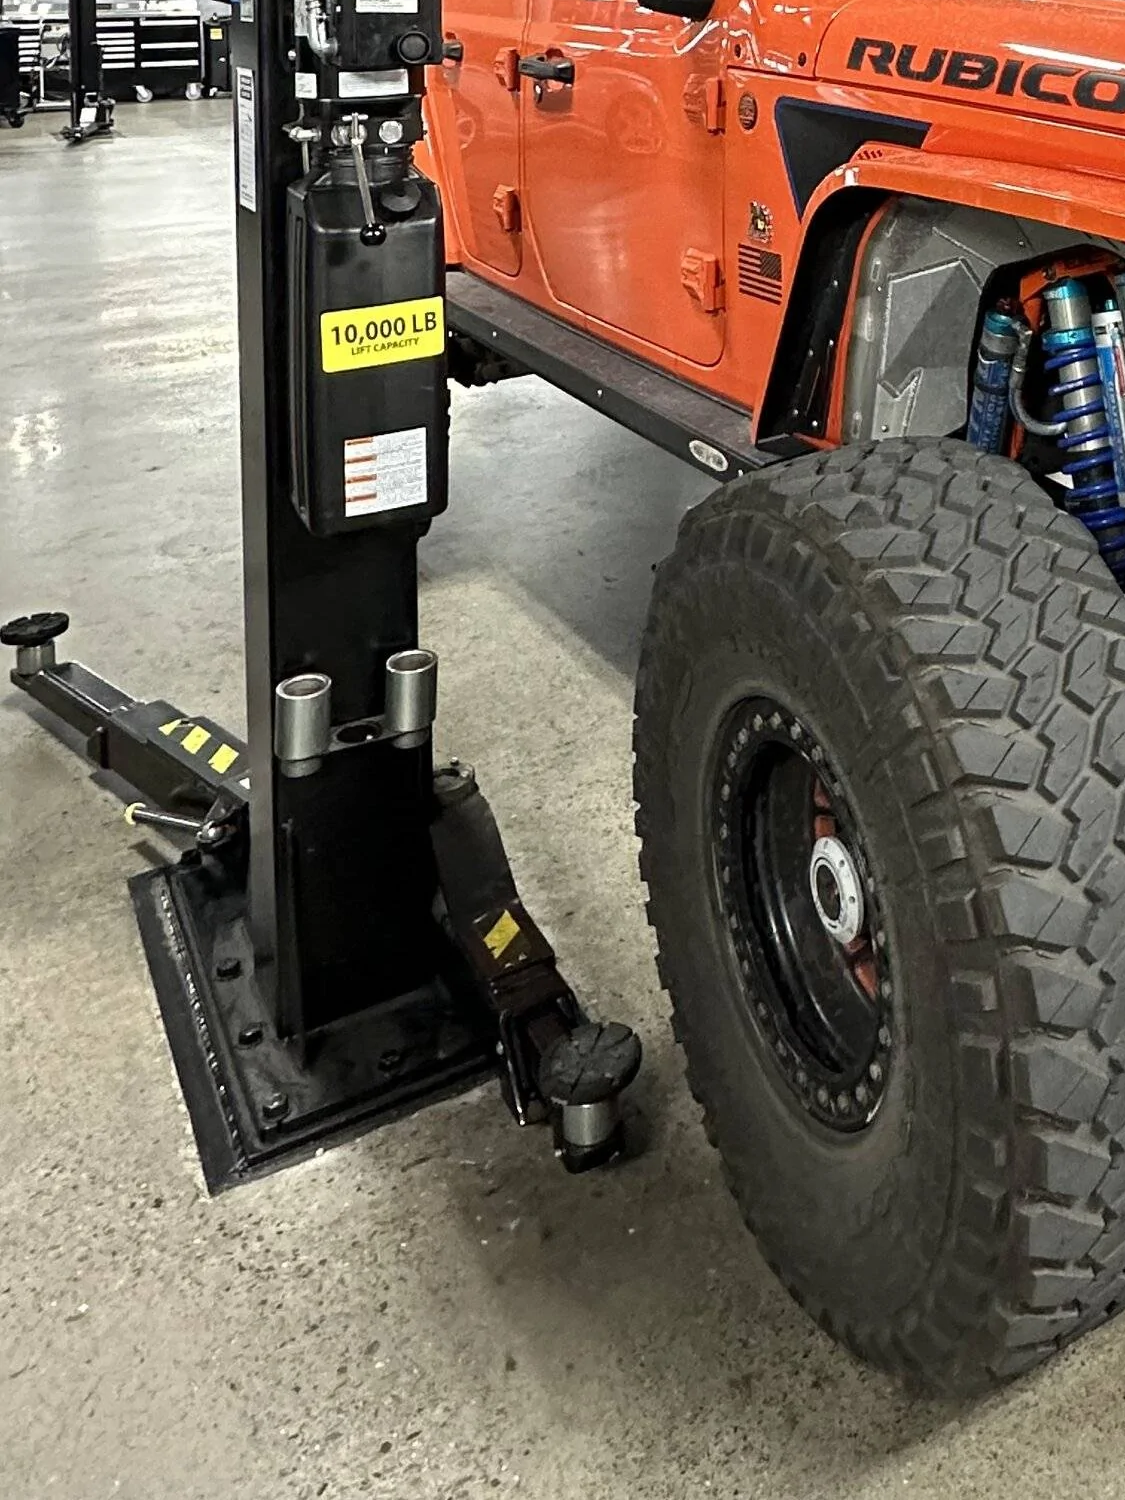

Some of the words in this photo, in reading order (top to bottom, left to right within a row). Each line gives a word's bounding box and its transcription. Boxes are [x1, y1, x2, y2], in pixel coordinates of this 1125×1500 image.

[331, 316, 406, 346] 10,000
[412, 311, 437, 333] LB
[351, 344, 371, 356] LIFT
[373, 337, 420, 353] CAPACITY
